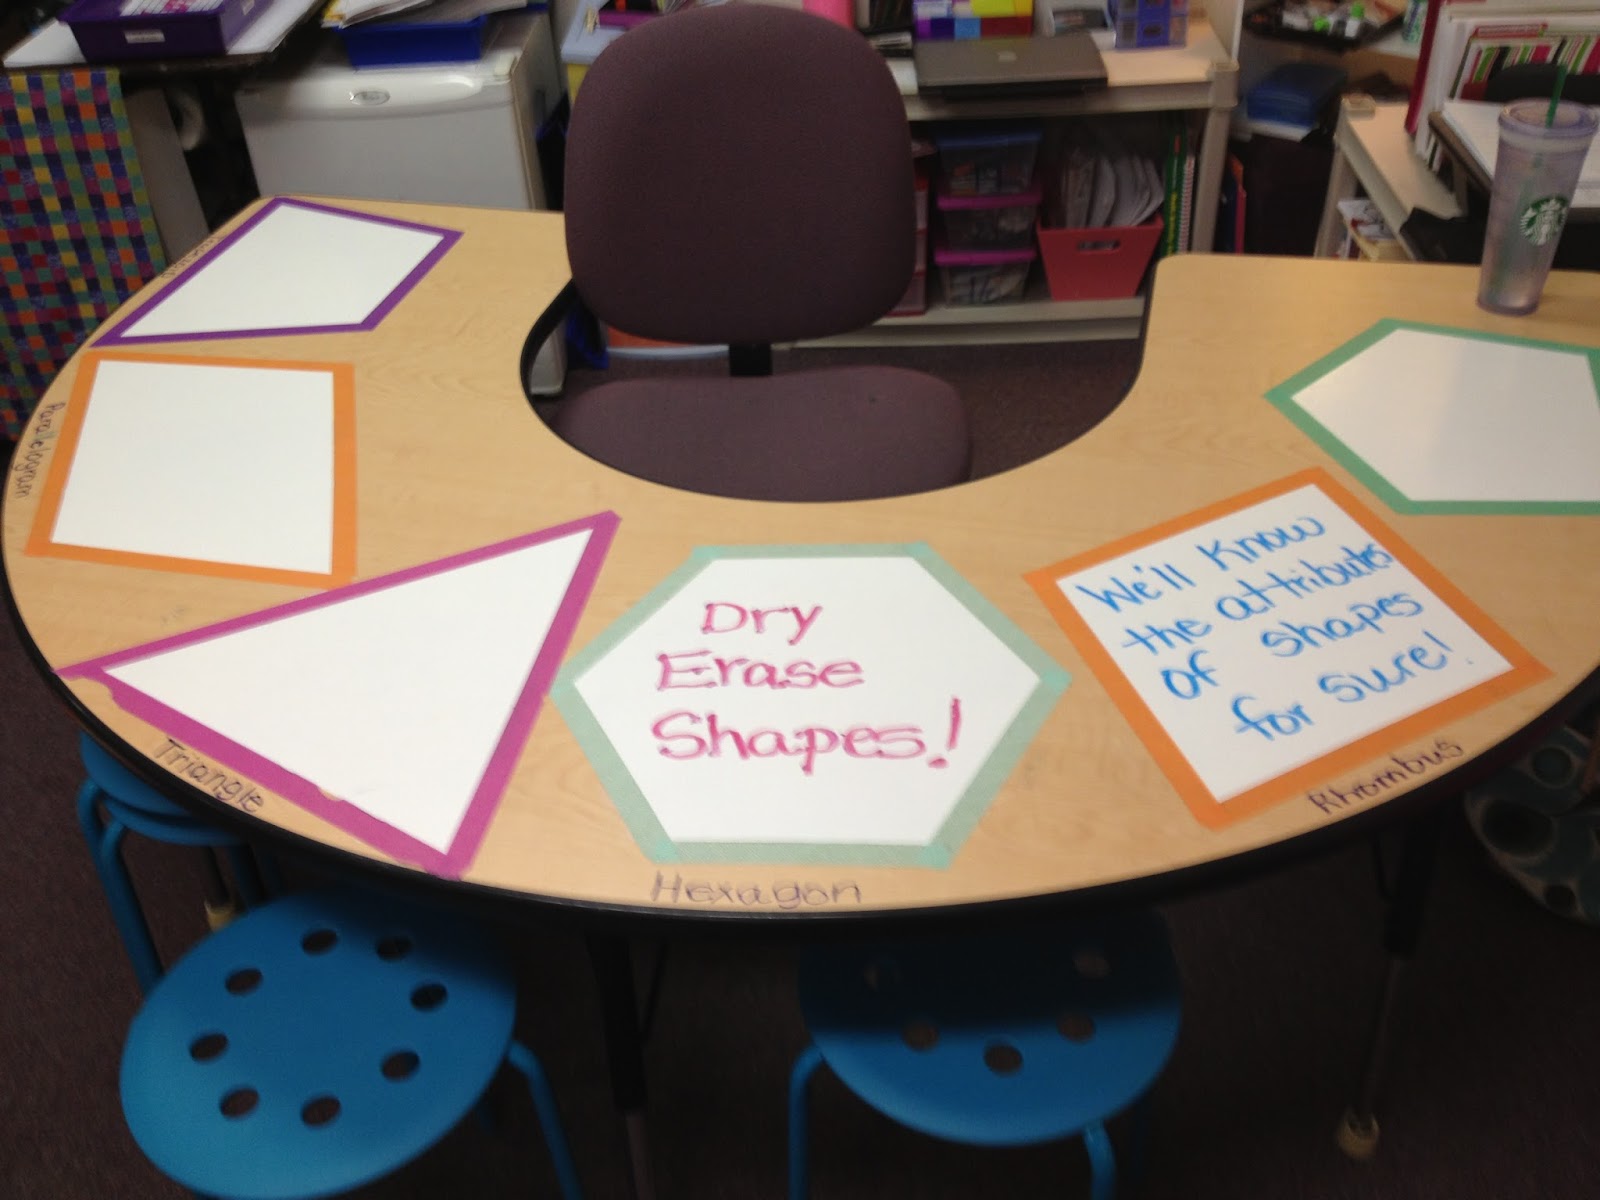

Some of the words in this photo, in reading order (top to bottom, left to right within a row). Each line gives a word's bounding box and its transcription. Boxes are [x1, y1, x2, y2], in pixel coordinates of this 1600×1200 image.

[1076, 563, 1196, 613] We'll
[701, 601, 823, 646] Dry
[1122, 616, 1213, 656] the
[656, 649, 865, 691] Erase
[650, 696, 963, 776] Shapes!
[1231, 695, 1315, 741] for
[155, 738, 264, 812] Triangle
[1307, 740, 1464, 815] Rhombus
[651, 870, 862, 910] Hexagon
